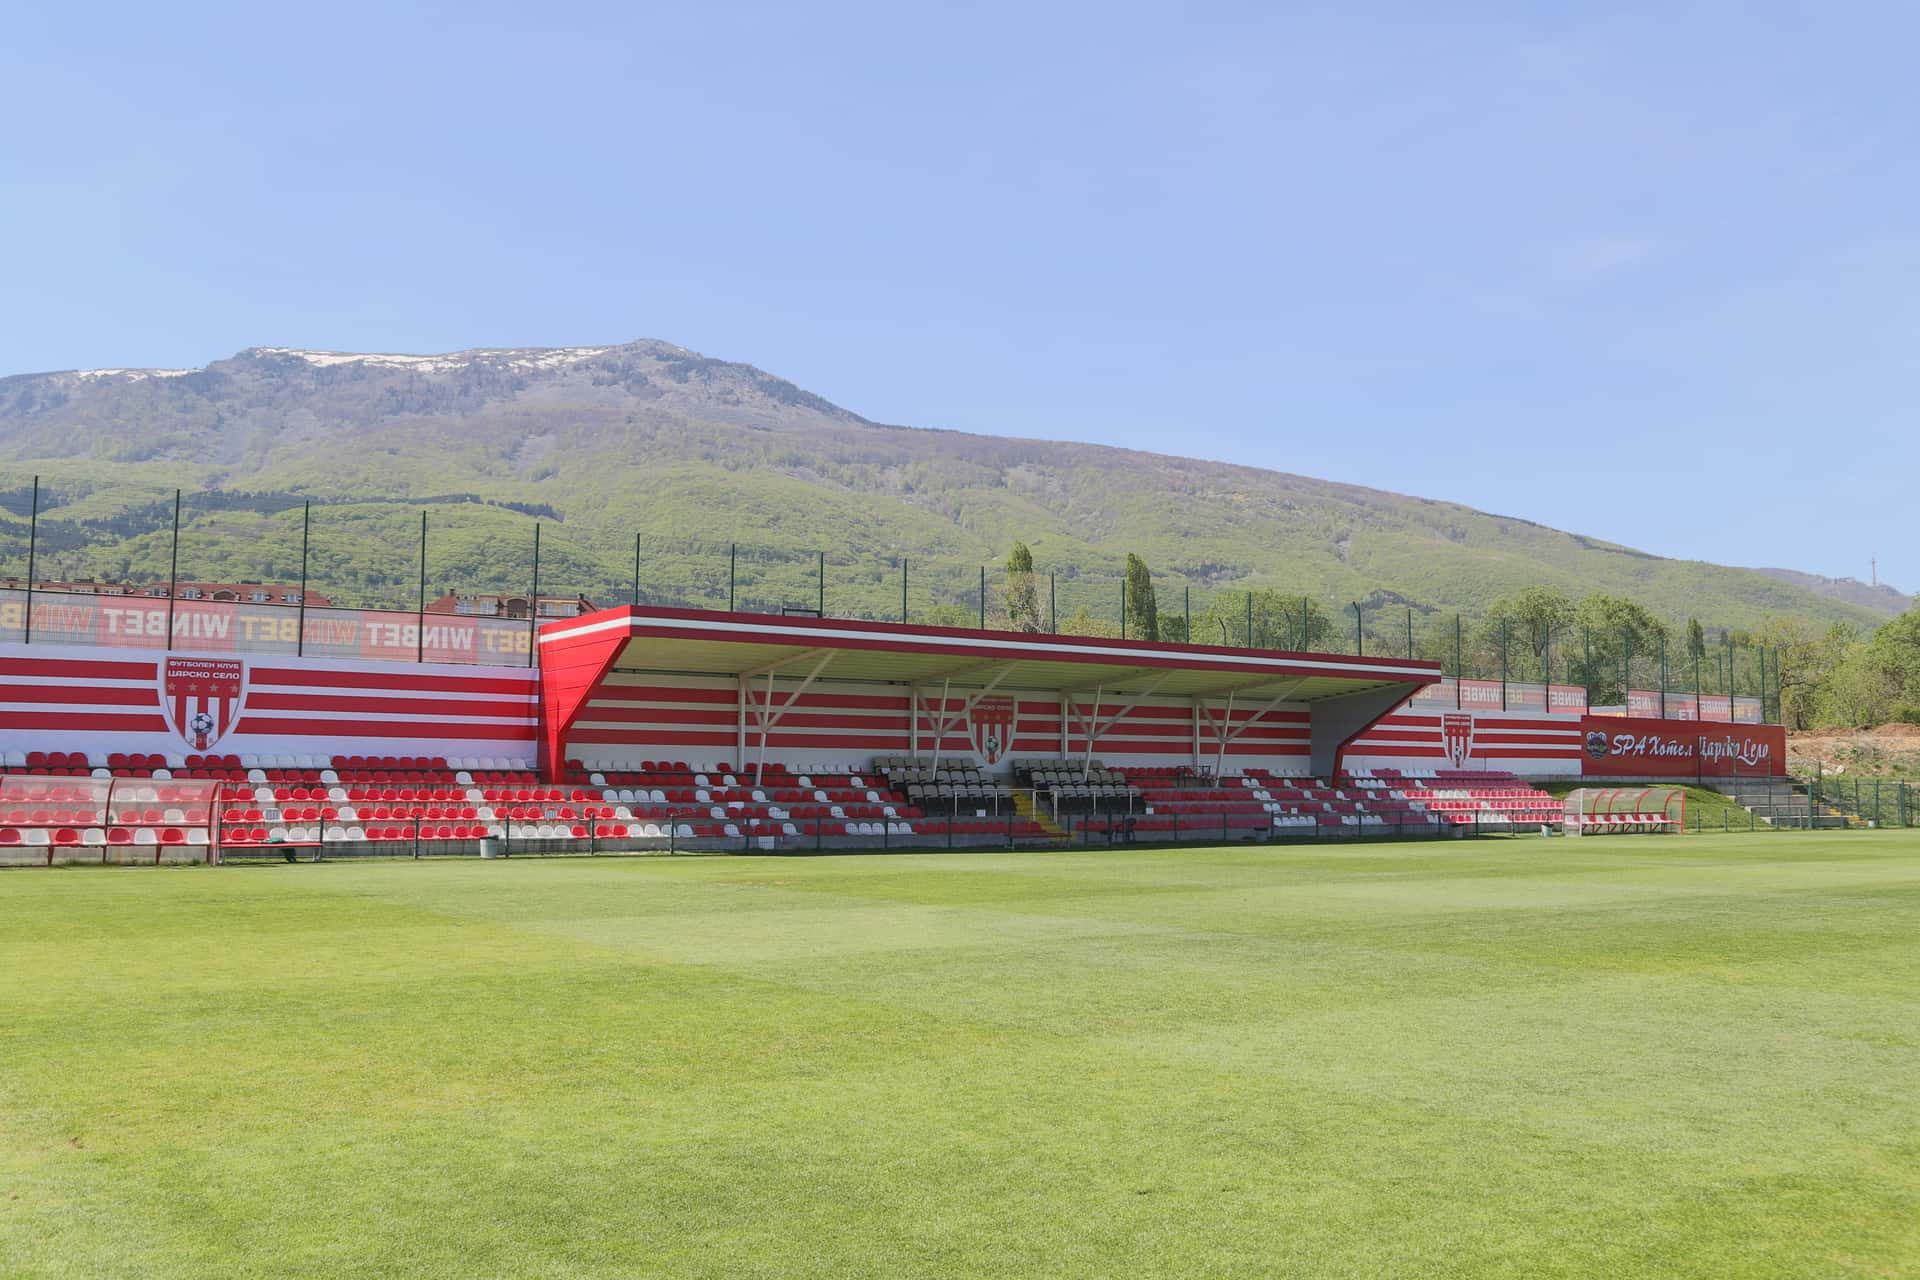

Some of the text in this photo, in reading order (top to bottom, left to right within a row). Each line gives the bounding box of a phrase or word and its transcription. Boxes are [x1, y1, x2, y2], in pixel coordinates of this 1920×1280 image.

[168, 670, 240, 680] ЦАРСКО СЕЛО
[1611, 734, 1647, 756] SPA
